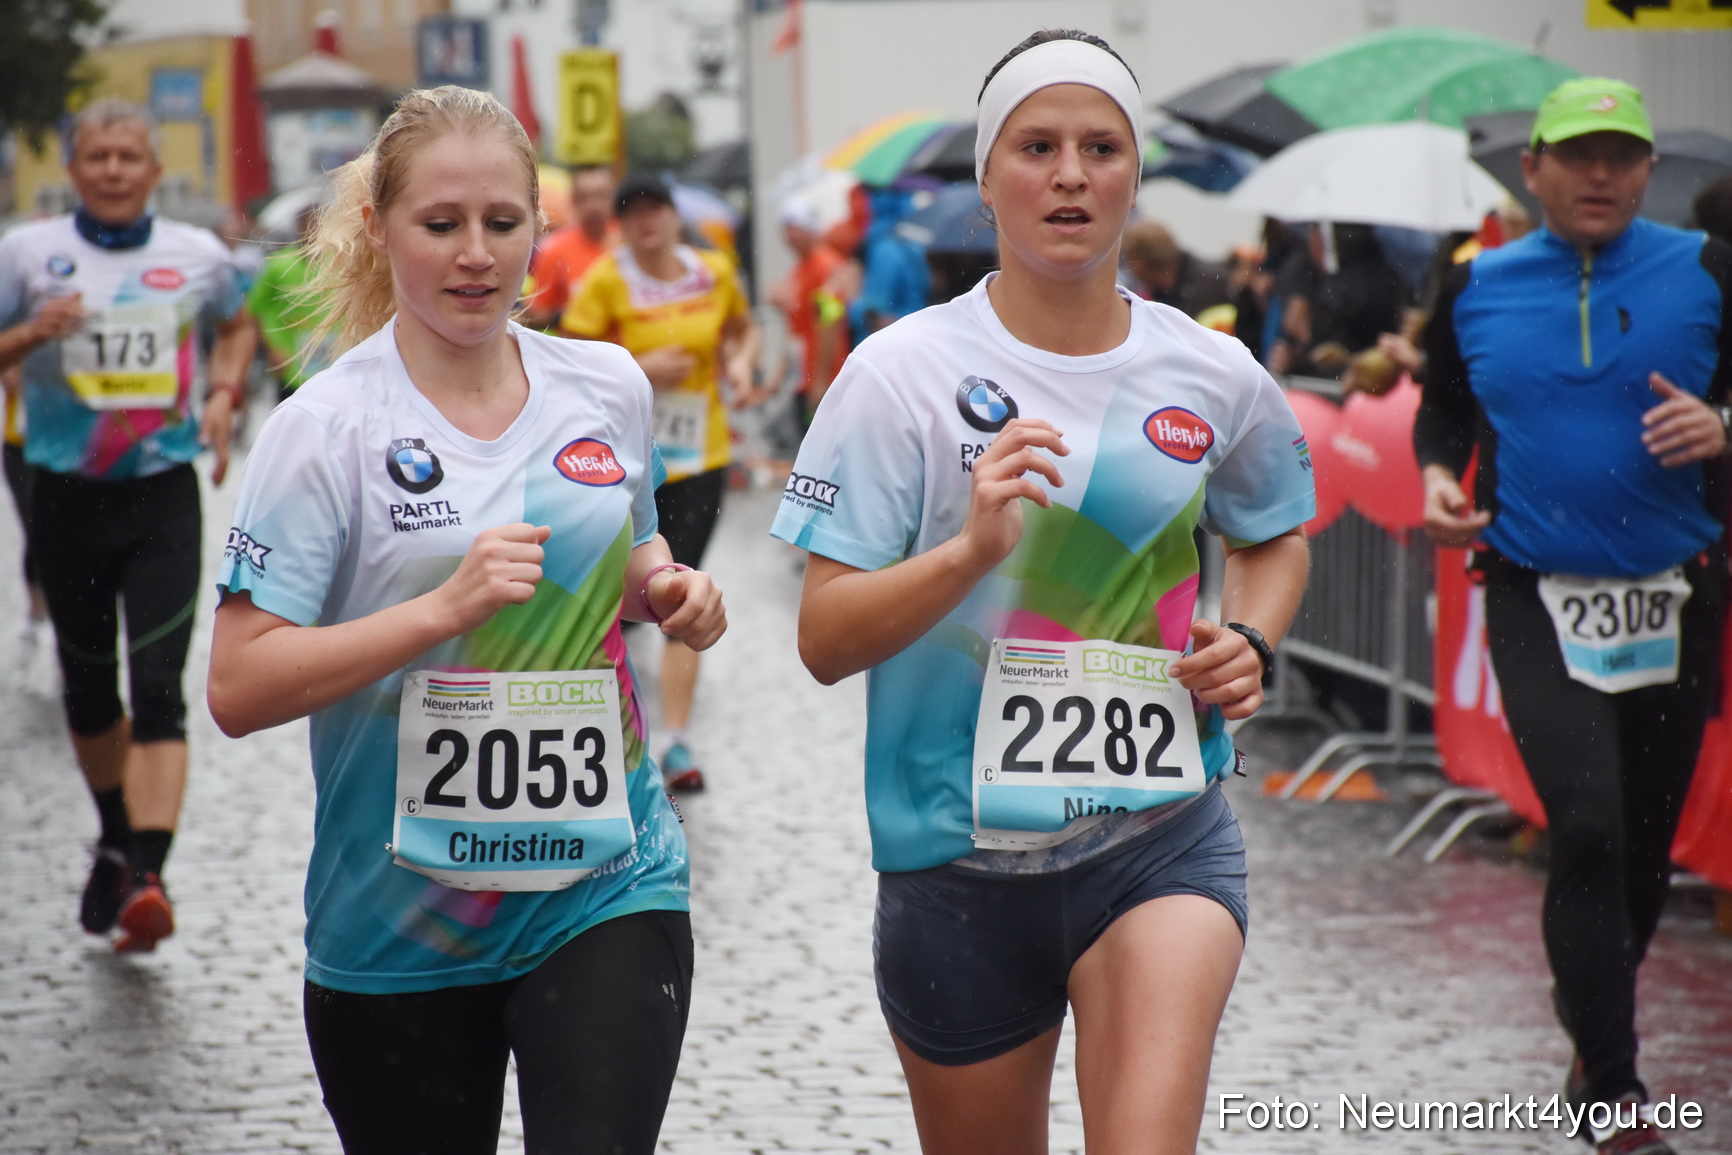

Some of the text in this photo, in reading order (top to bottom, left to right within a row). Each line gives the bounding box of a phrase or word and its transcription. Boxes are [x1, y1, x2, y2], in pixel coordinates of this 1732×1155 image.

[573, 80, 608, 136] D
[90, 331, 156, 367] 173
[1155, 419, 1208, 449] Hervis
[563, 452, 618, 474] Hervis
[390, 500, 459, 519] PARTL
[393, 516, 462, 532] Neumarkt
[1562, 588, 1673, 640] 2308
[1000, 664, 1069, 679] NeuerMarkt
[1083, 648, 1170, 684] BOCK
[422, 697, 494, 712] NeuerMarkt
[507, 680, 606, 706] BOCK
[508, 708, 542, 717] inspired
[578, 707, 608, 716] concepts
[1000, 694, 1183, 778] 2282
[423, 726, 609, 811] 2053
[449, 832, 584, 863] Christina
